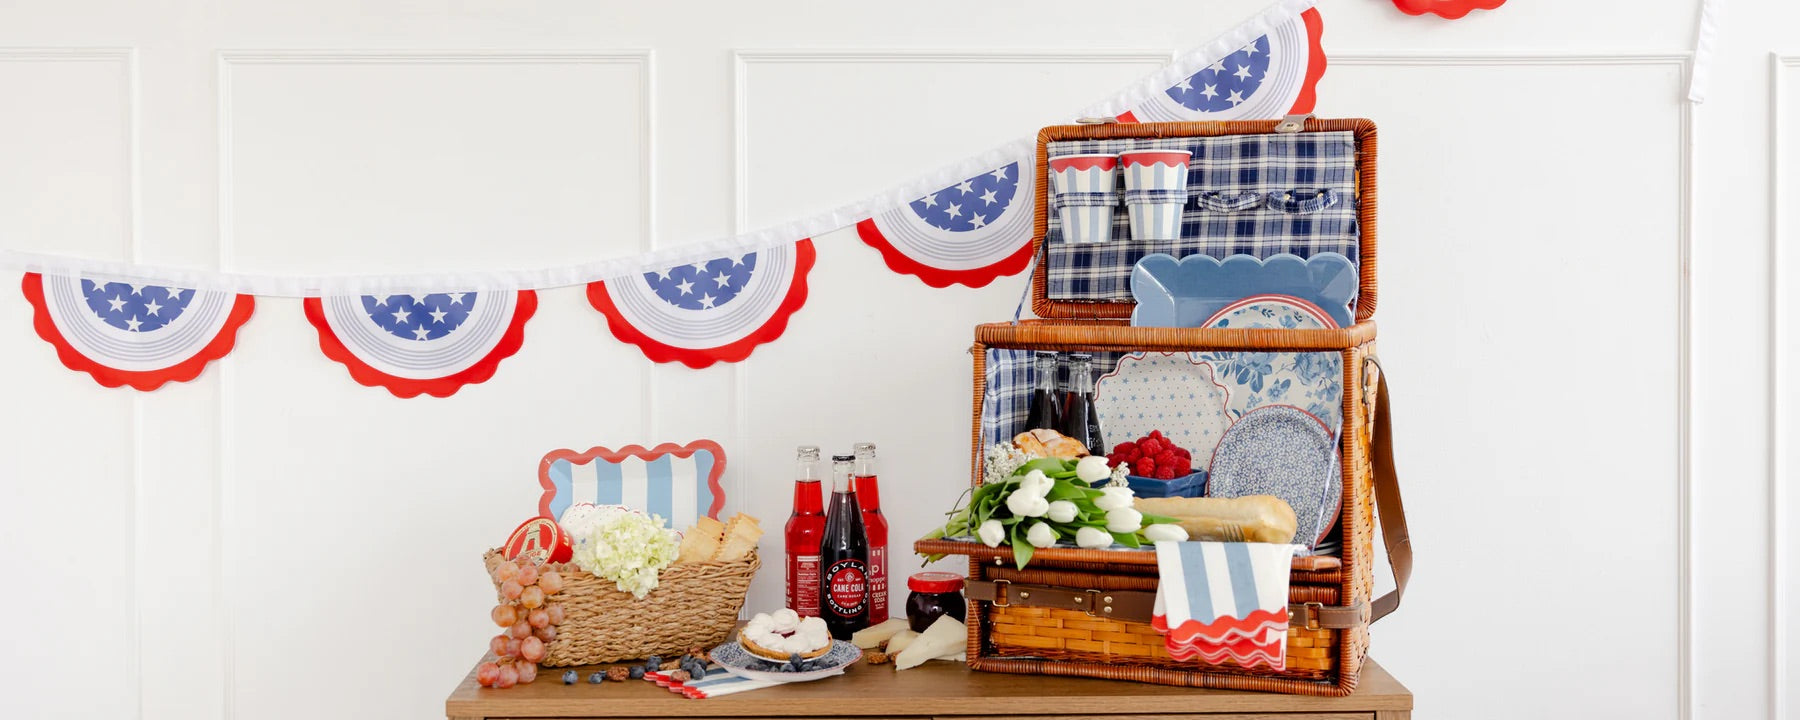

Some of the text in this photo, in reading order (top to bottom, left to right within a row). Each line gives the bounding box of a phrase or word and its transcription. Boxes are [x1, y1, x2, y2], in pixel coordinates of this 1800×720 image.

[826, 562, 869, 581] BOYLAN
[833, 583, 865, 593] CANE COLA
[827, 593, 863, 614] BOTTLING
